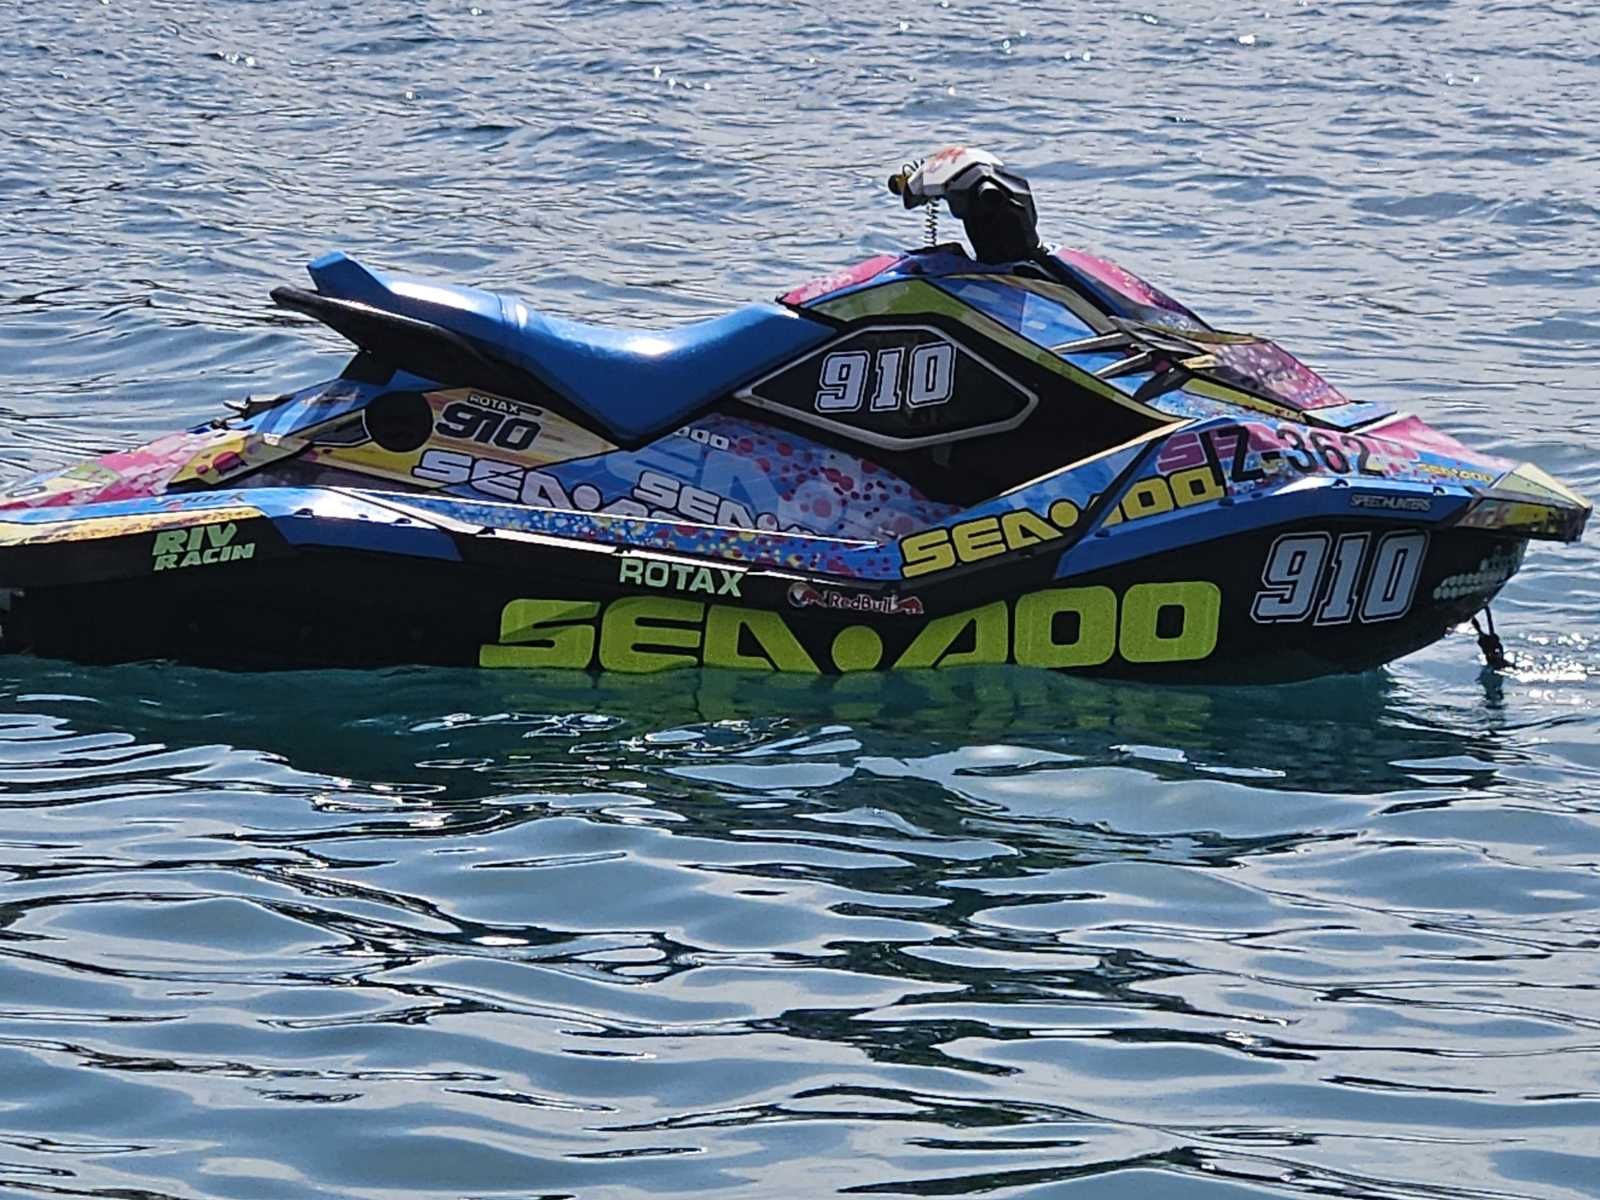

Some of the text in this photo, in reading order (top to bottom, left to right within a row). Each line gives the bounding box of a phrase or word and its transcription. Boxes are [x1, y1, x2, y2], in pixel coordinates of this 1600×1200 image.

[815, 341, 956, 413] 910
[469, 393, 520, 414] ROTAX
[434, 402, 542, 451] 910
[152, 522, 237, 556] RIV
[153, 543, 256, 572] RACIN
[619, 558, 744, 598] ROTAX
[1250, 530, 1428, 625] 910
